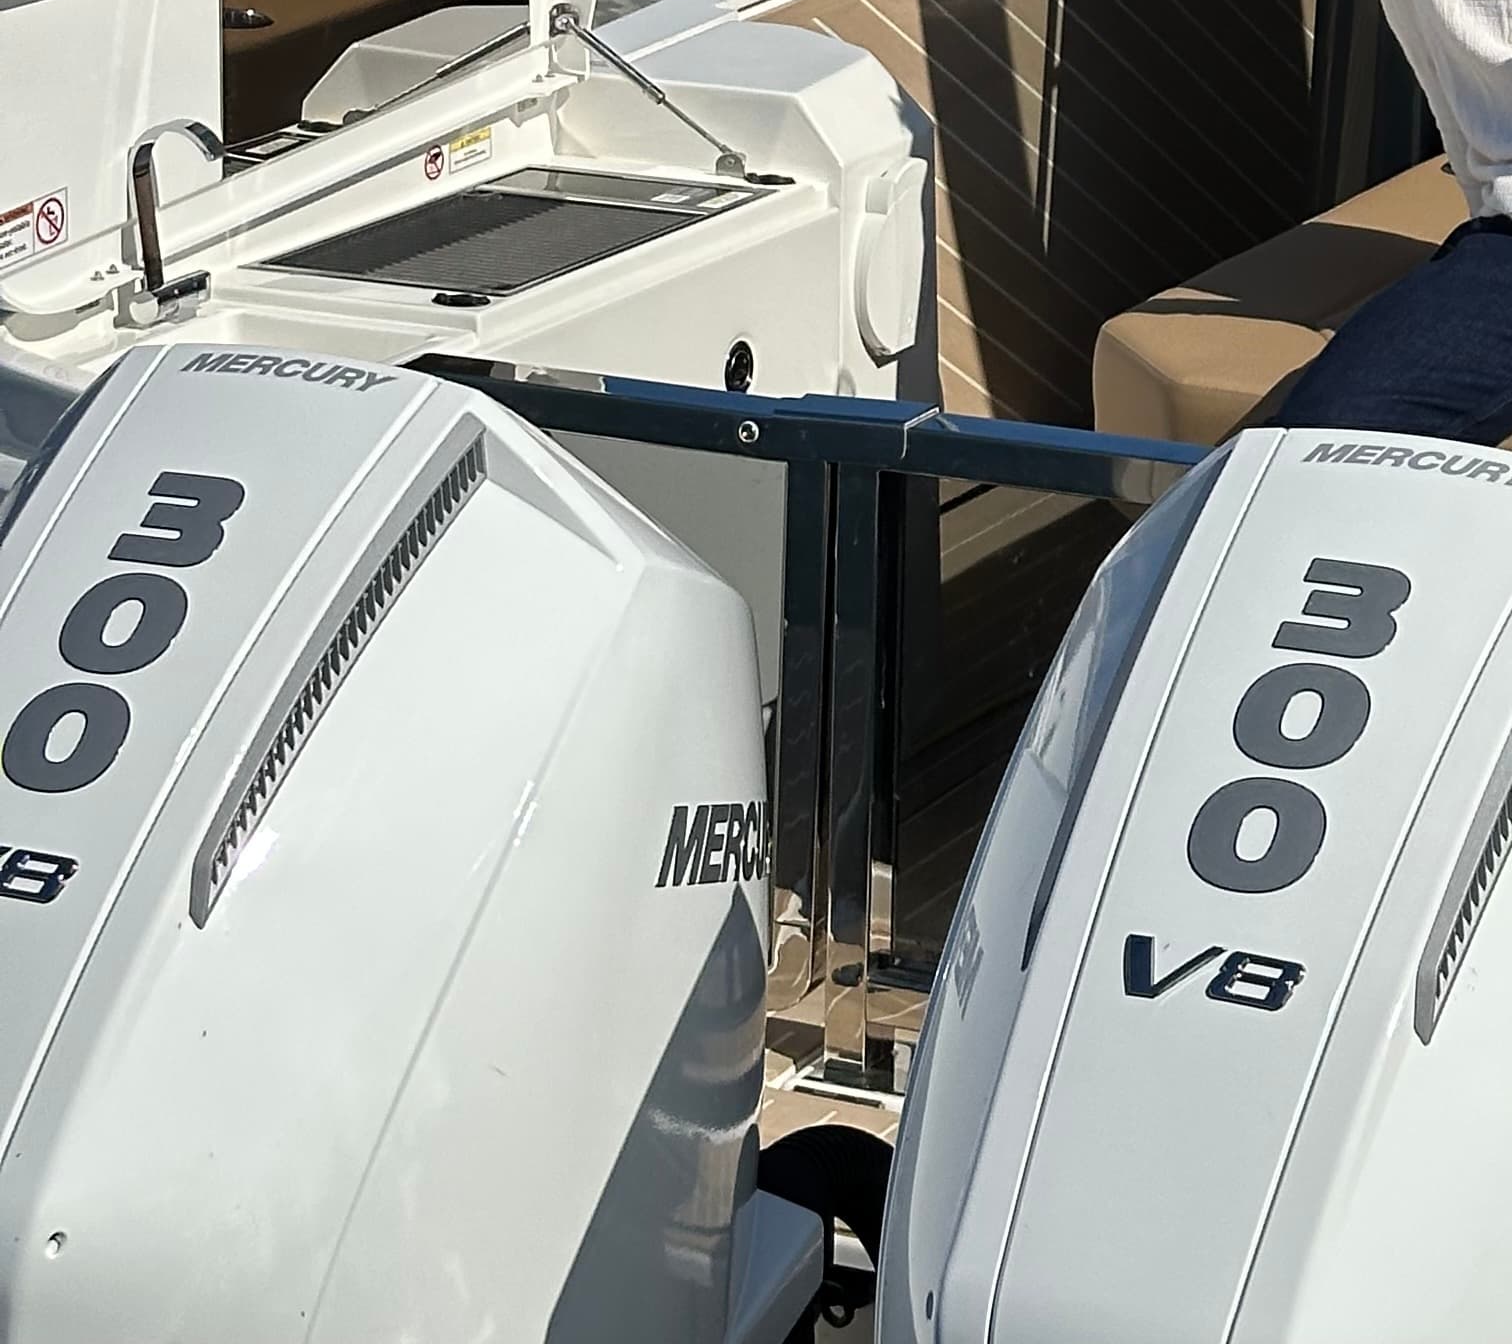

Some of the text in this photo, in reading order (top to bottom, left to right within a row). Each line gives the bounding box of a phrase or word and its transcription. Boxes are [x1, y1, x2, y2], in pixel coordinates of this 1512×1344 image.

[180, 352, 399, 392] MERCURY
[1, 471, 246, 794] 300
[1187, 557, 1412, 894] 300
[0, 844, 80, 904] 8
[1123, 934, 1306, 1012] V8
